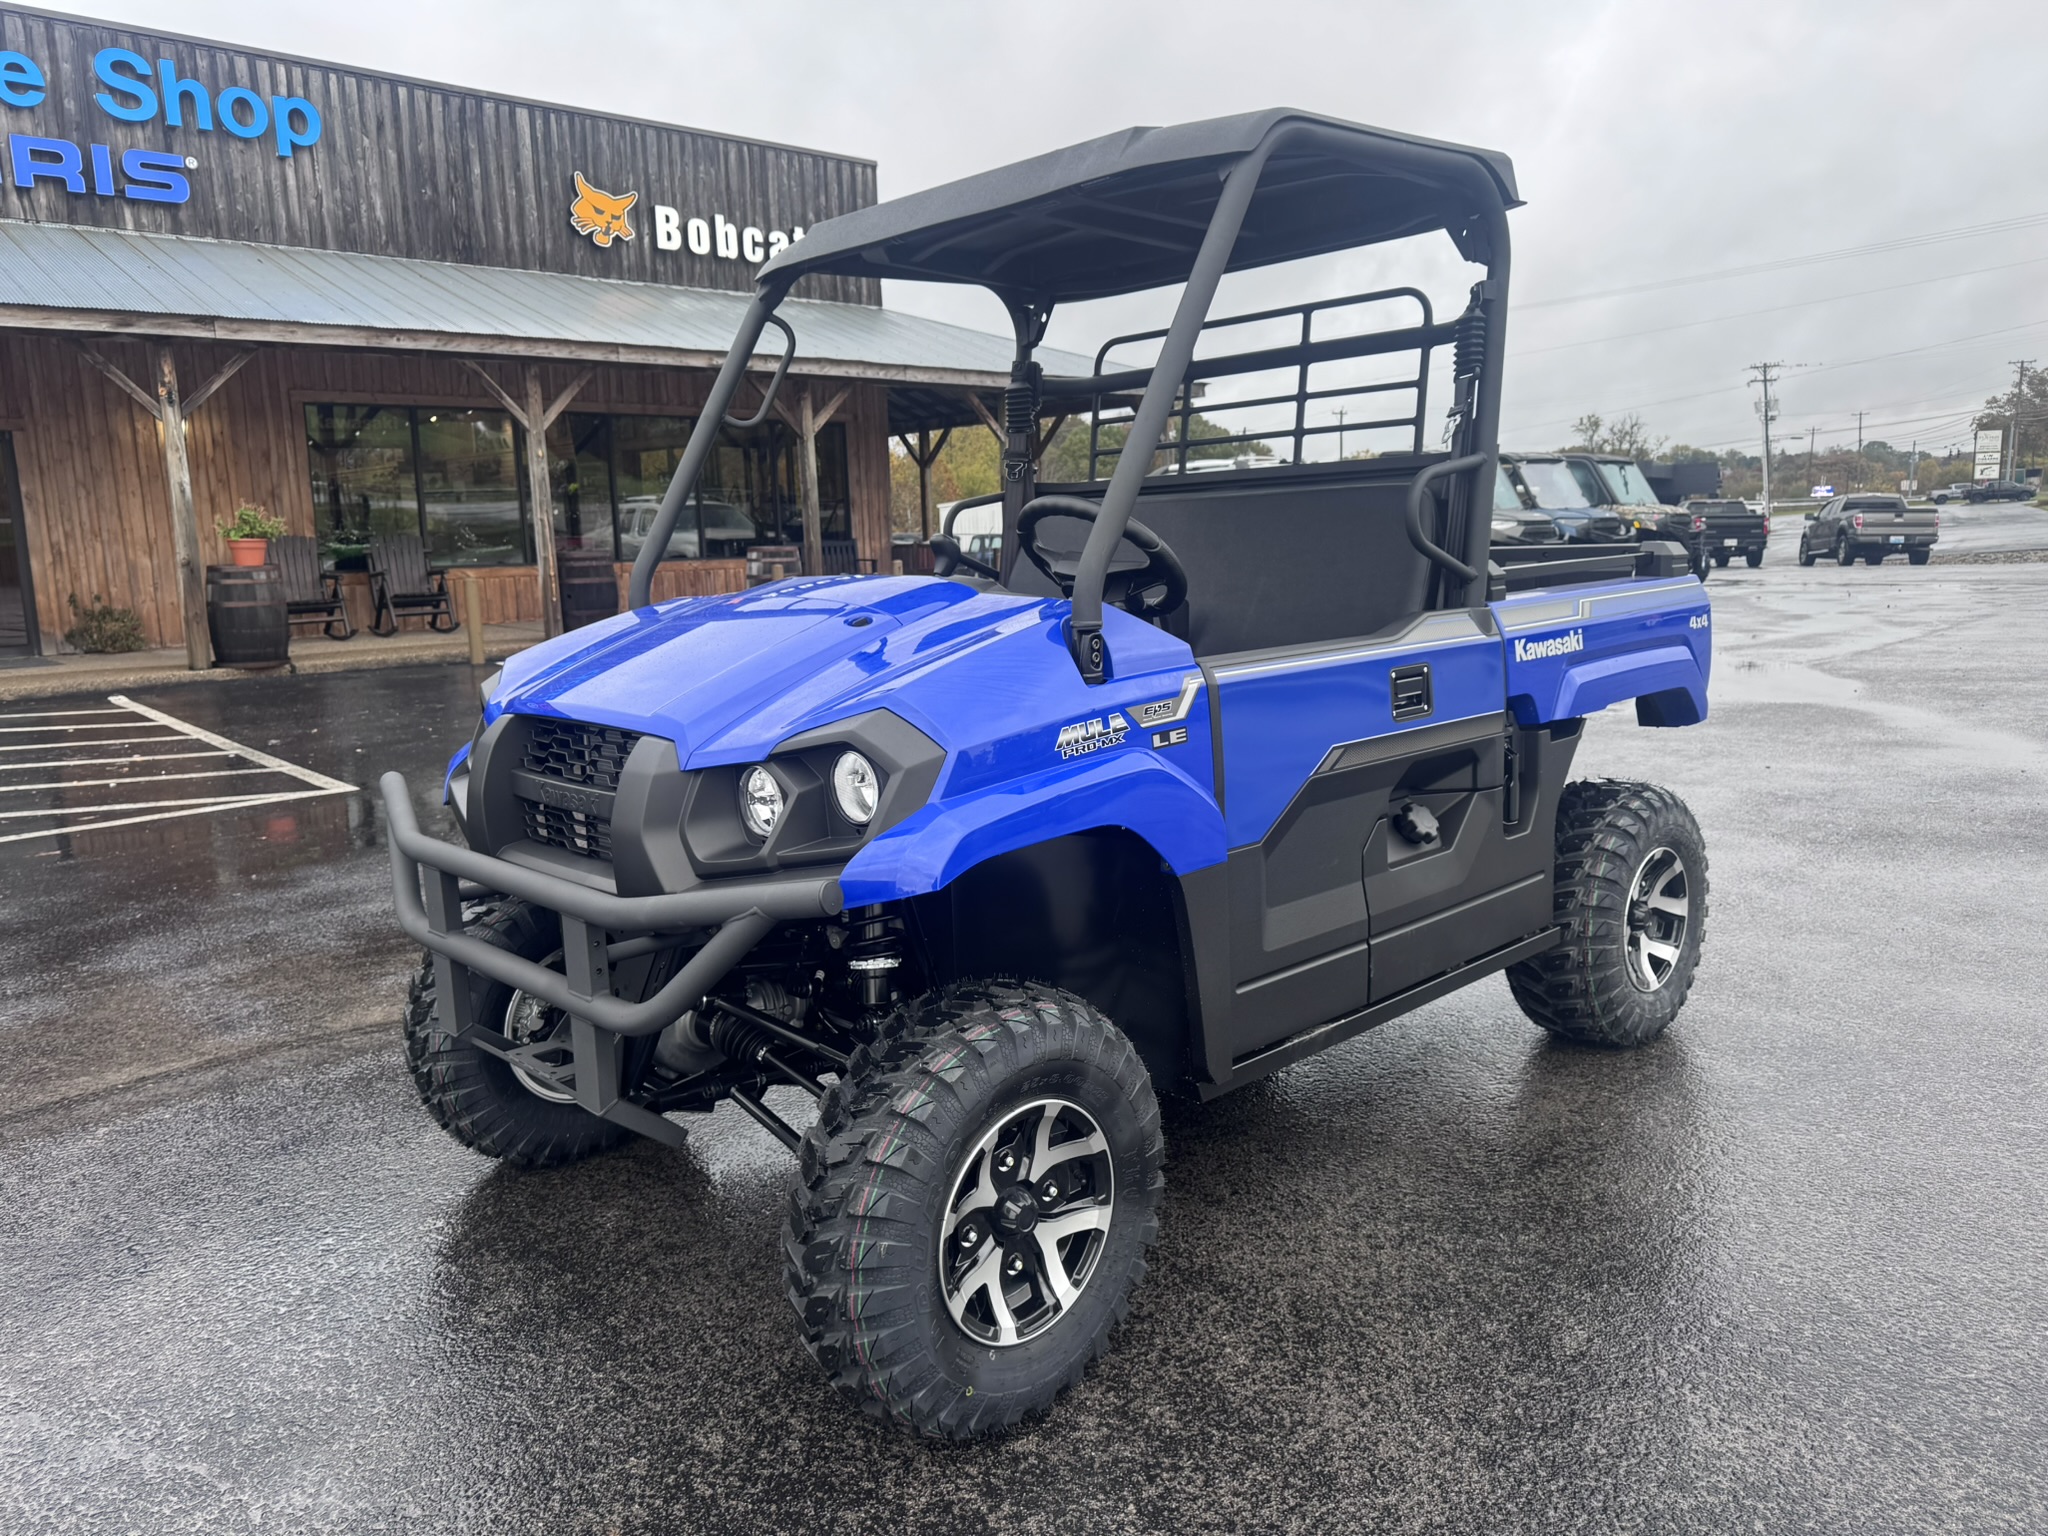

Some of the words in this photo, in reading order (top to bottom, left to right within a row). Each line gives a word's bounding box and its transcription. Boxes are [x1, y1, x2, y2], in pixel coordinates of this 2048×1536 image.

[93, 47, 322, 159] Shop
[0, 133, 191, 204] RIS
[1689, 614, 1709, 629] 4x4
[1515, 628, 1584, 662] Kawasaki
[1055, 712, 1131, 750] MULE
[1152, 727, 1187, 748] LE
